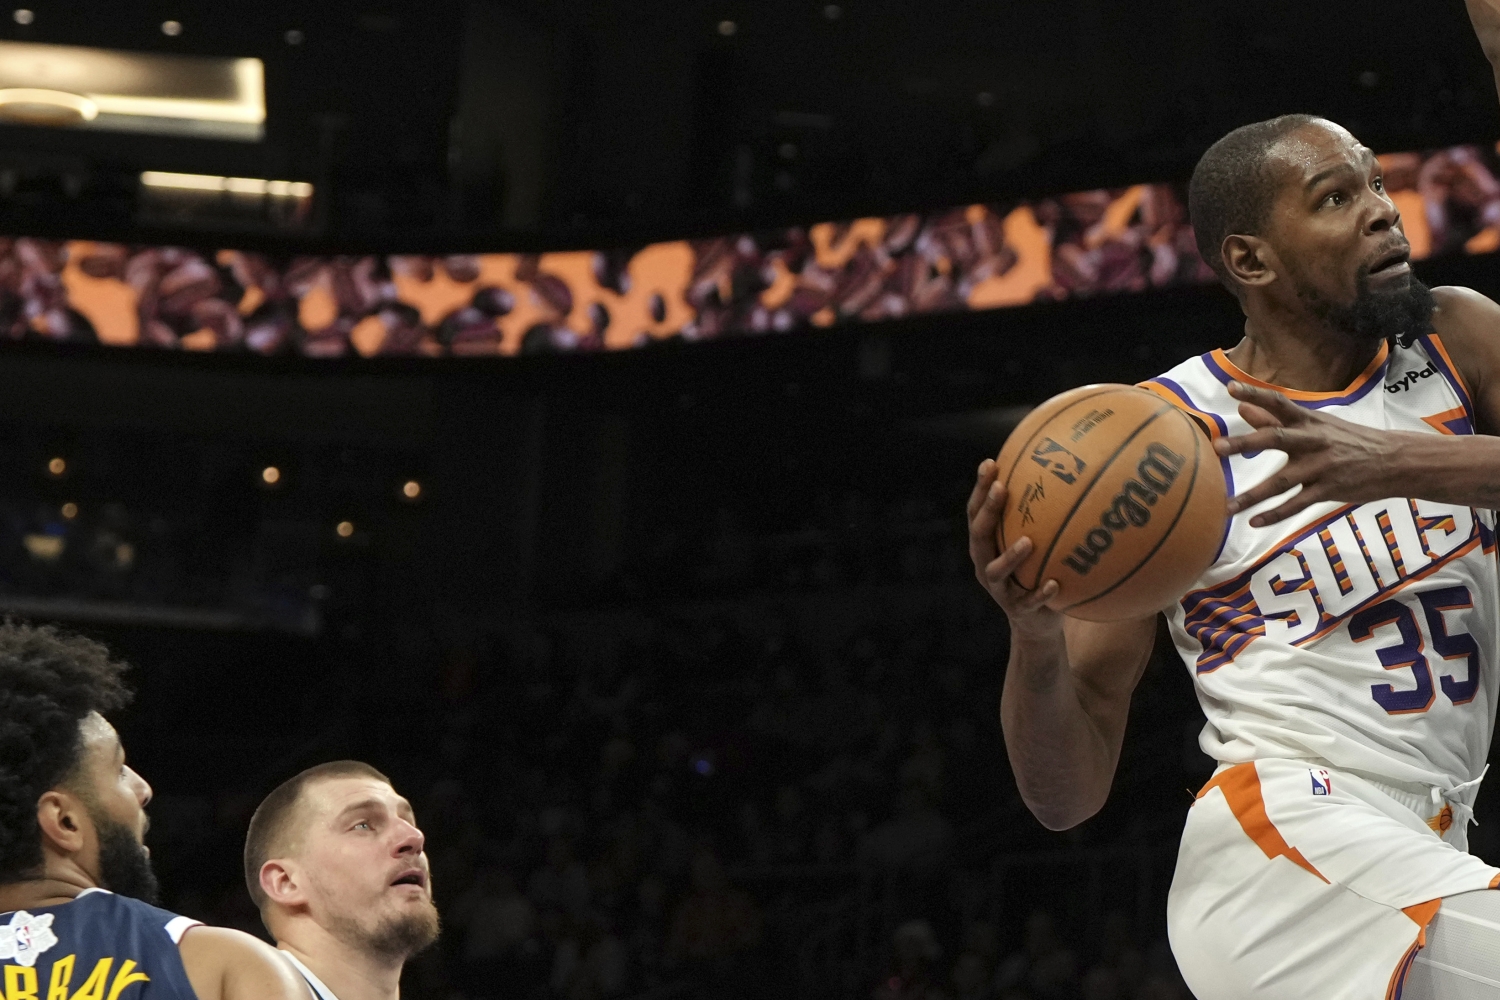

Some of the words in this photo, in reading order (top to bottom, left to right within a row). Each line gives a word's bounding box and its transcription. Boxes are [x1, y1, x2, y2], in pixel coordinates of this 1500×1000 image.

[1383, 361, 1438, 393] ayPal
[1061, 441, 1186, 575] Wilson
[1250, 497, 1474, 643] SUNS
[1347, 585, 1481, 715] 35
